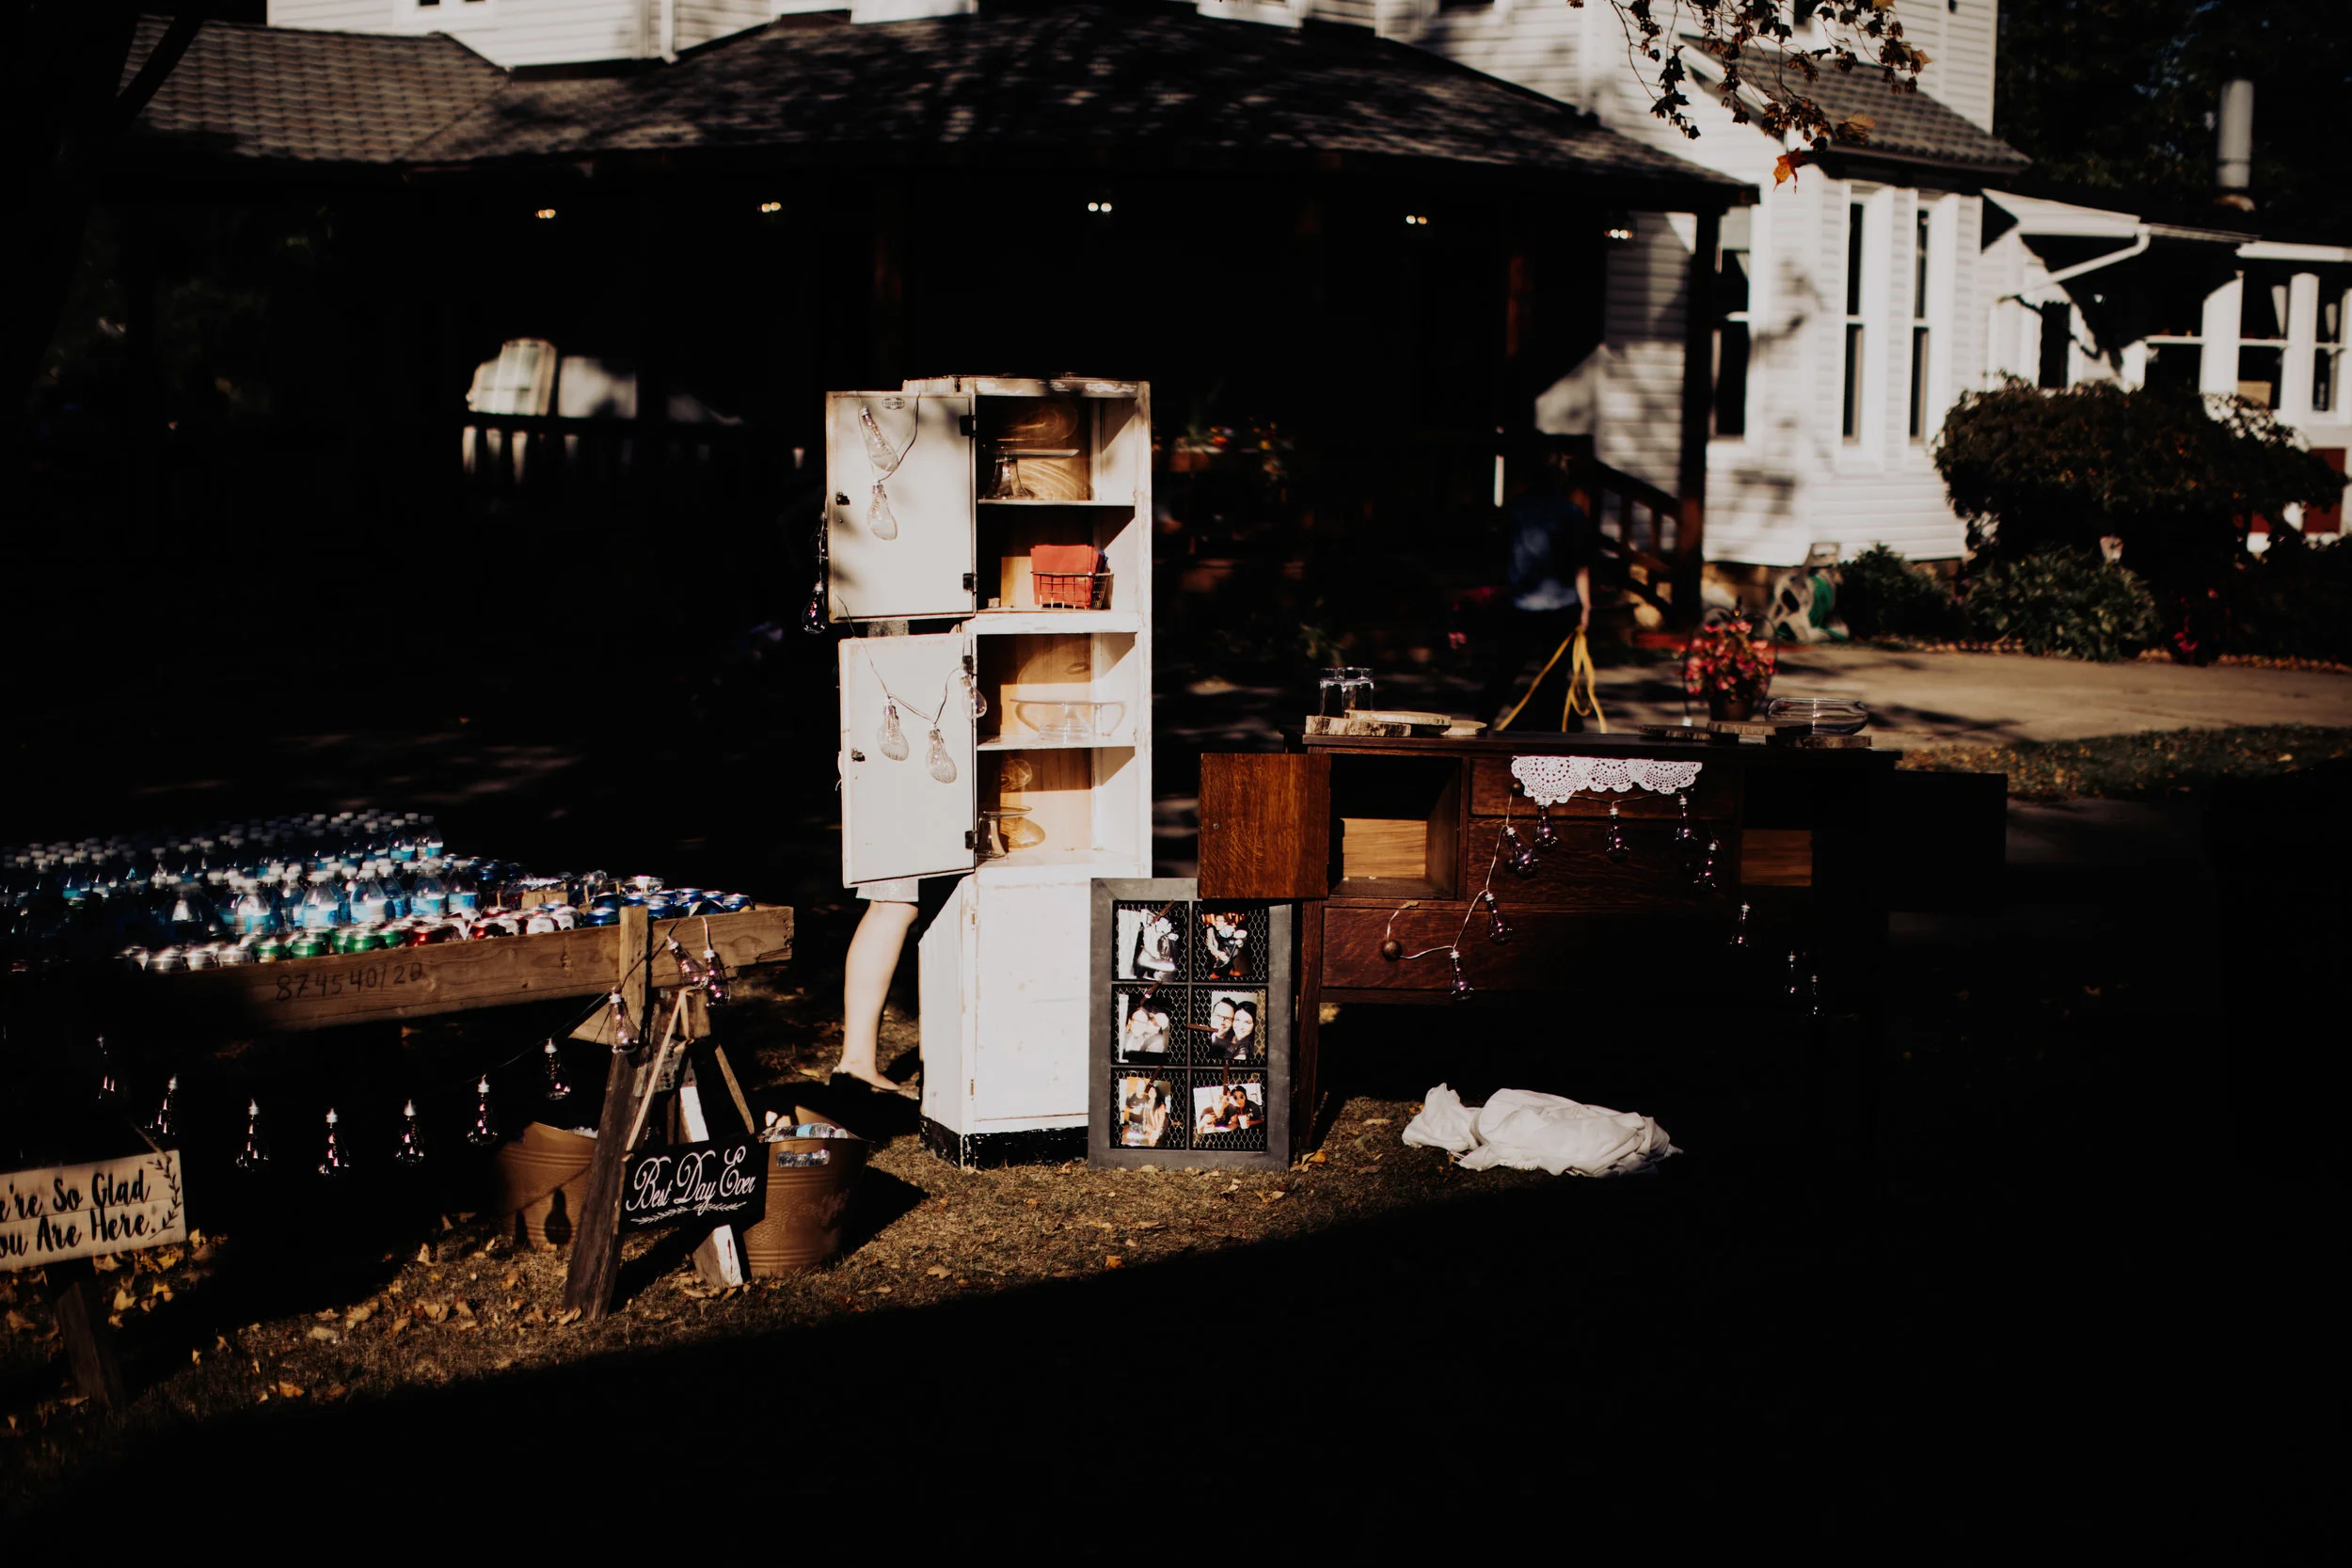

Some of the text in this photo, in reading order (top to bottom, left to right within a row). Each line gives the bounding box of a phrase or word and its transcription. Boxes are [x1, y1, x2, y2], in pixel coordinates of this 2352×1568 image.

[0, 1169, 151, 1222] e're So Glad
[626, 1146, 756, 1216] Best Day Ever
[0, 1208, 156, 1258] ou Are Here.
